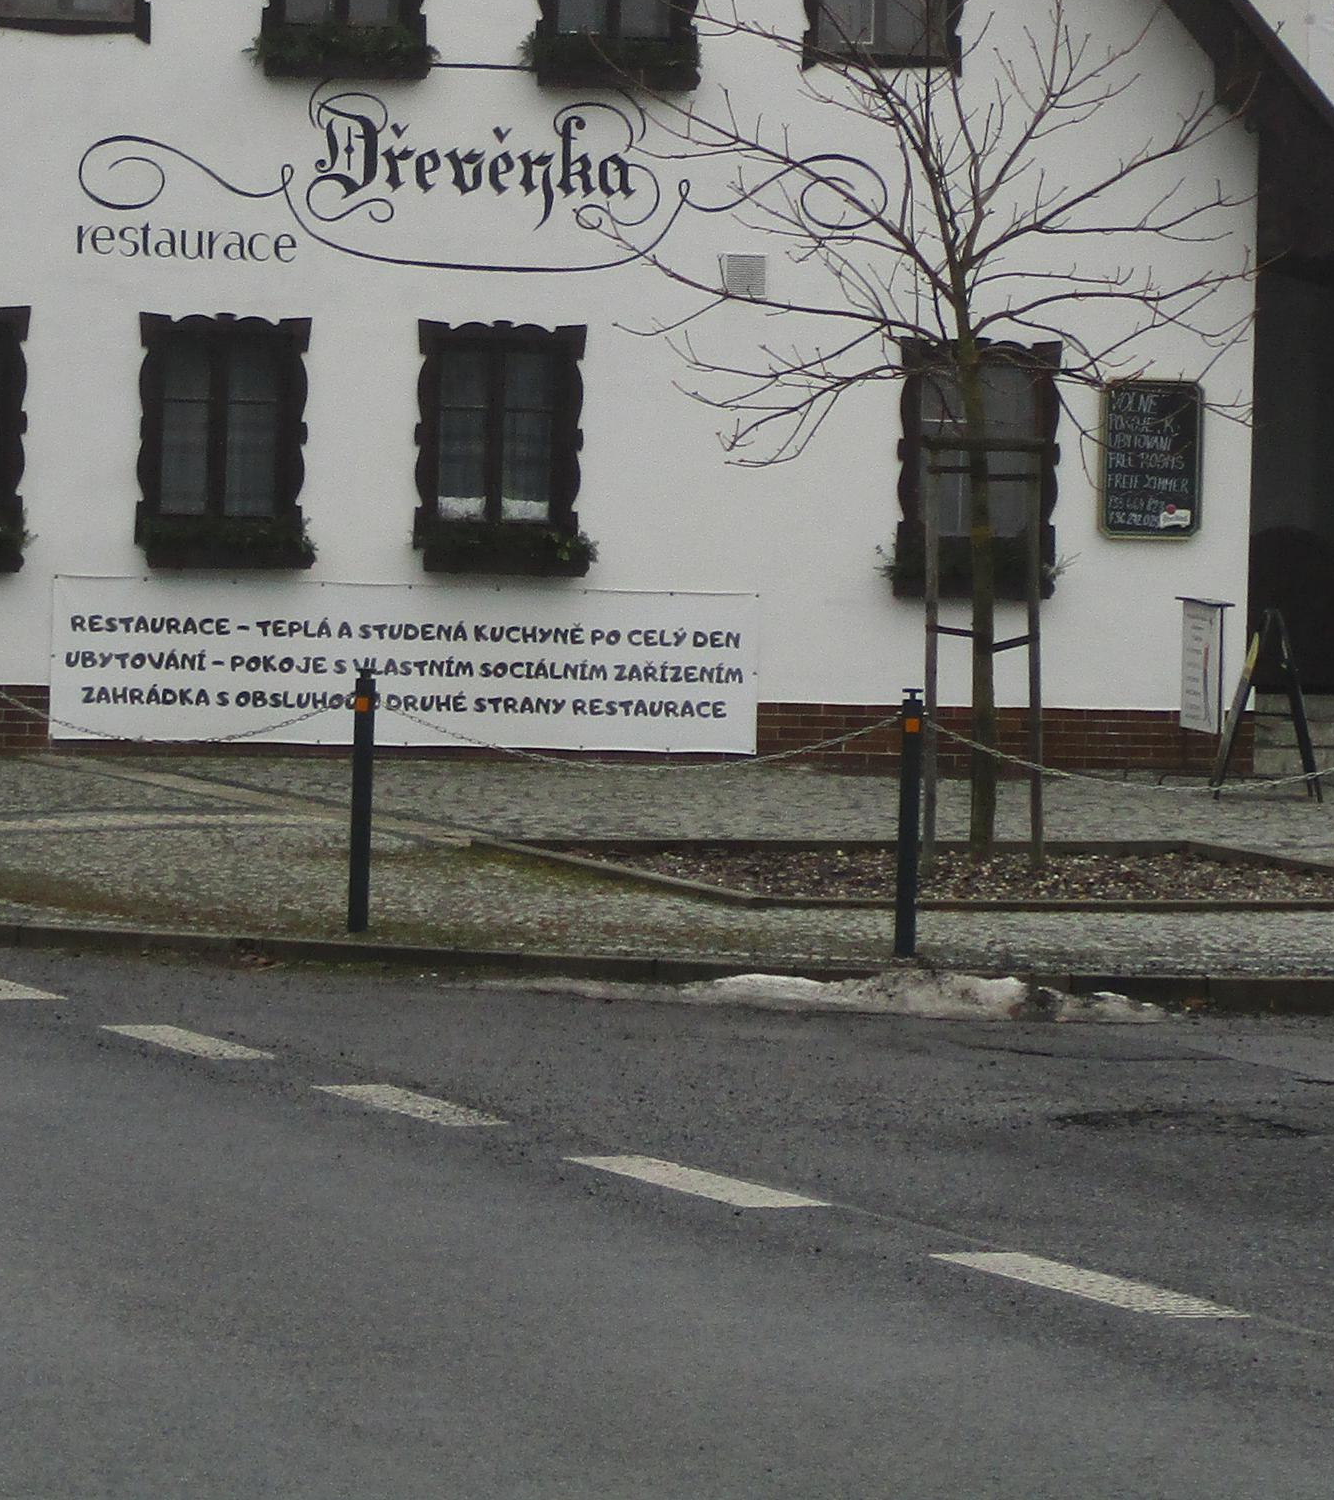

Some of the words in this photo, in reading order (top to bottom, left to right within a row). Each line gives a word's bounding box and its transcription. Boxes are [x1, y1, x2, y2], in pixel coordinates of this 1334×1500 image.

[311, 96, 641, 230] Dřevěnka
[76, 221, 297, 263] restaurace
[70, 615, 231, 636] RESTAURACE
[256, 618, 332, 638] TEPLÁ
[338, 621, 353, 639] A
[358, 620, 468, 642] STUDENÁ
[474, 622, 585, 645] KUCHYNĚ
[590, 629, 621, 646] PO
[627, 627, 687, 647] CELÝ
[692, 630, 742, 649] DEN
[65, 649, 207, 672] UBYTOVÁNÍ
[230, 655, 328, 675] POKOJE
[333, 659, 347, 674] S
[353, 656, 475, 678] VLASTNÍM
[479, 658, 609, 682] SOCIÁLNÍM
[614, 660, 744, 684] ZAŘÍZENÍM
[81, 684, 210, 706] ZAHRÁDKA
[216, 691, 230, 707] S
[386, 690, 468, 712] DRUHÉ
[473, 695, 567, 715] STRANY
[571, 698, 728, 719] RESTAURACE
